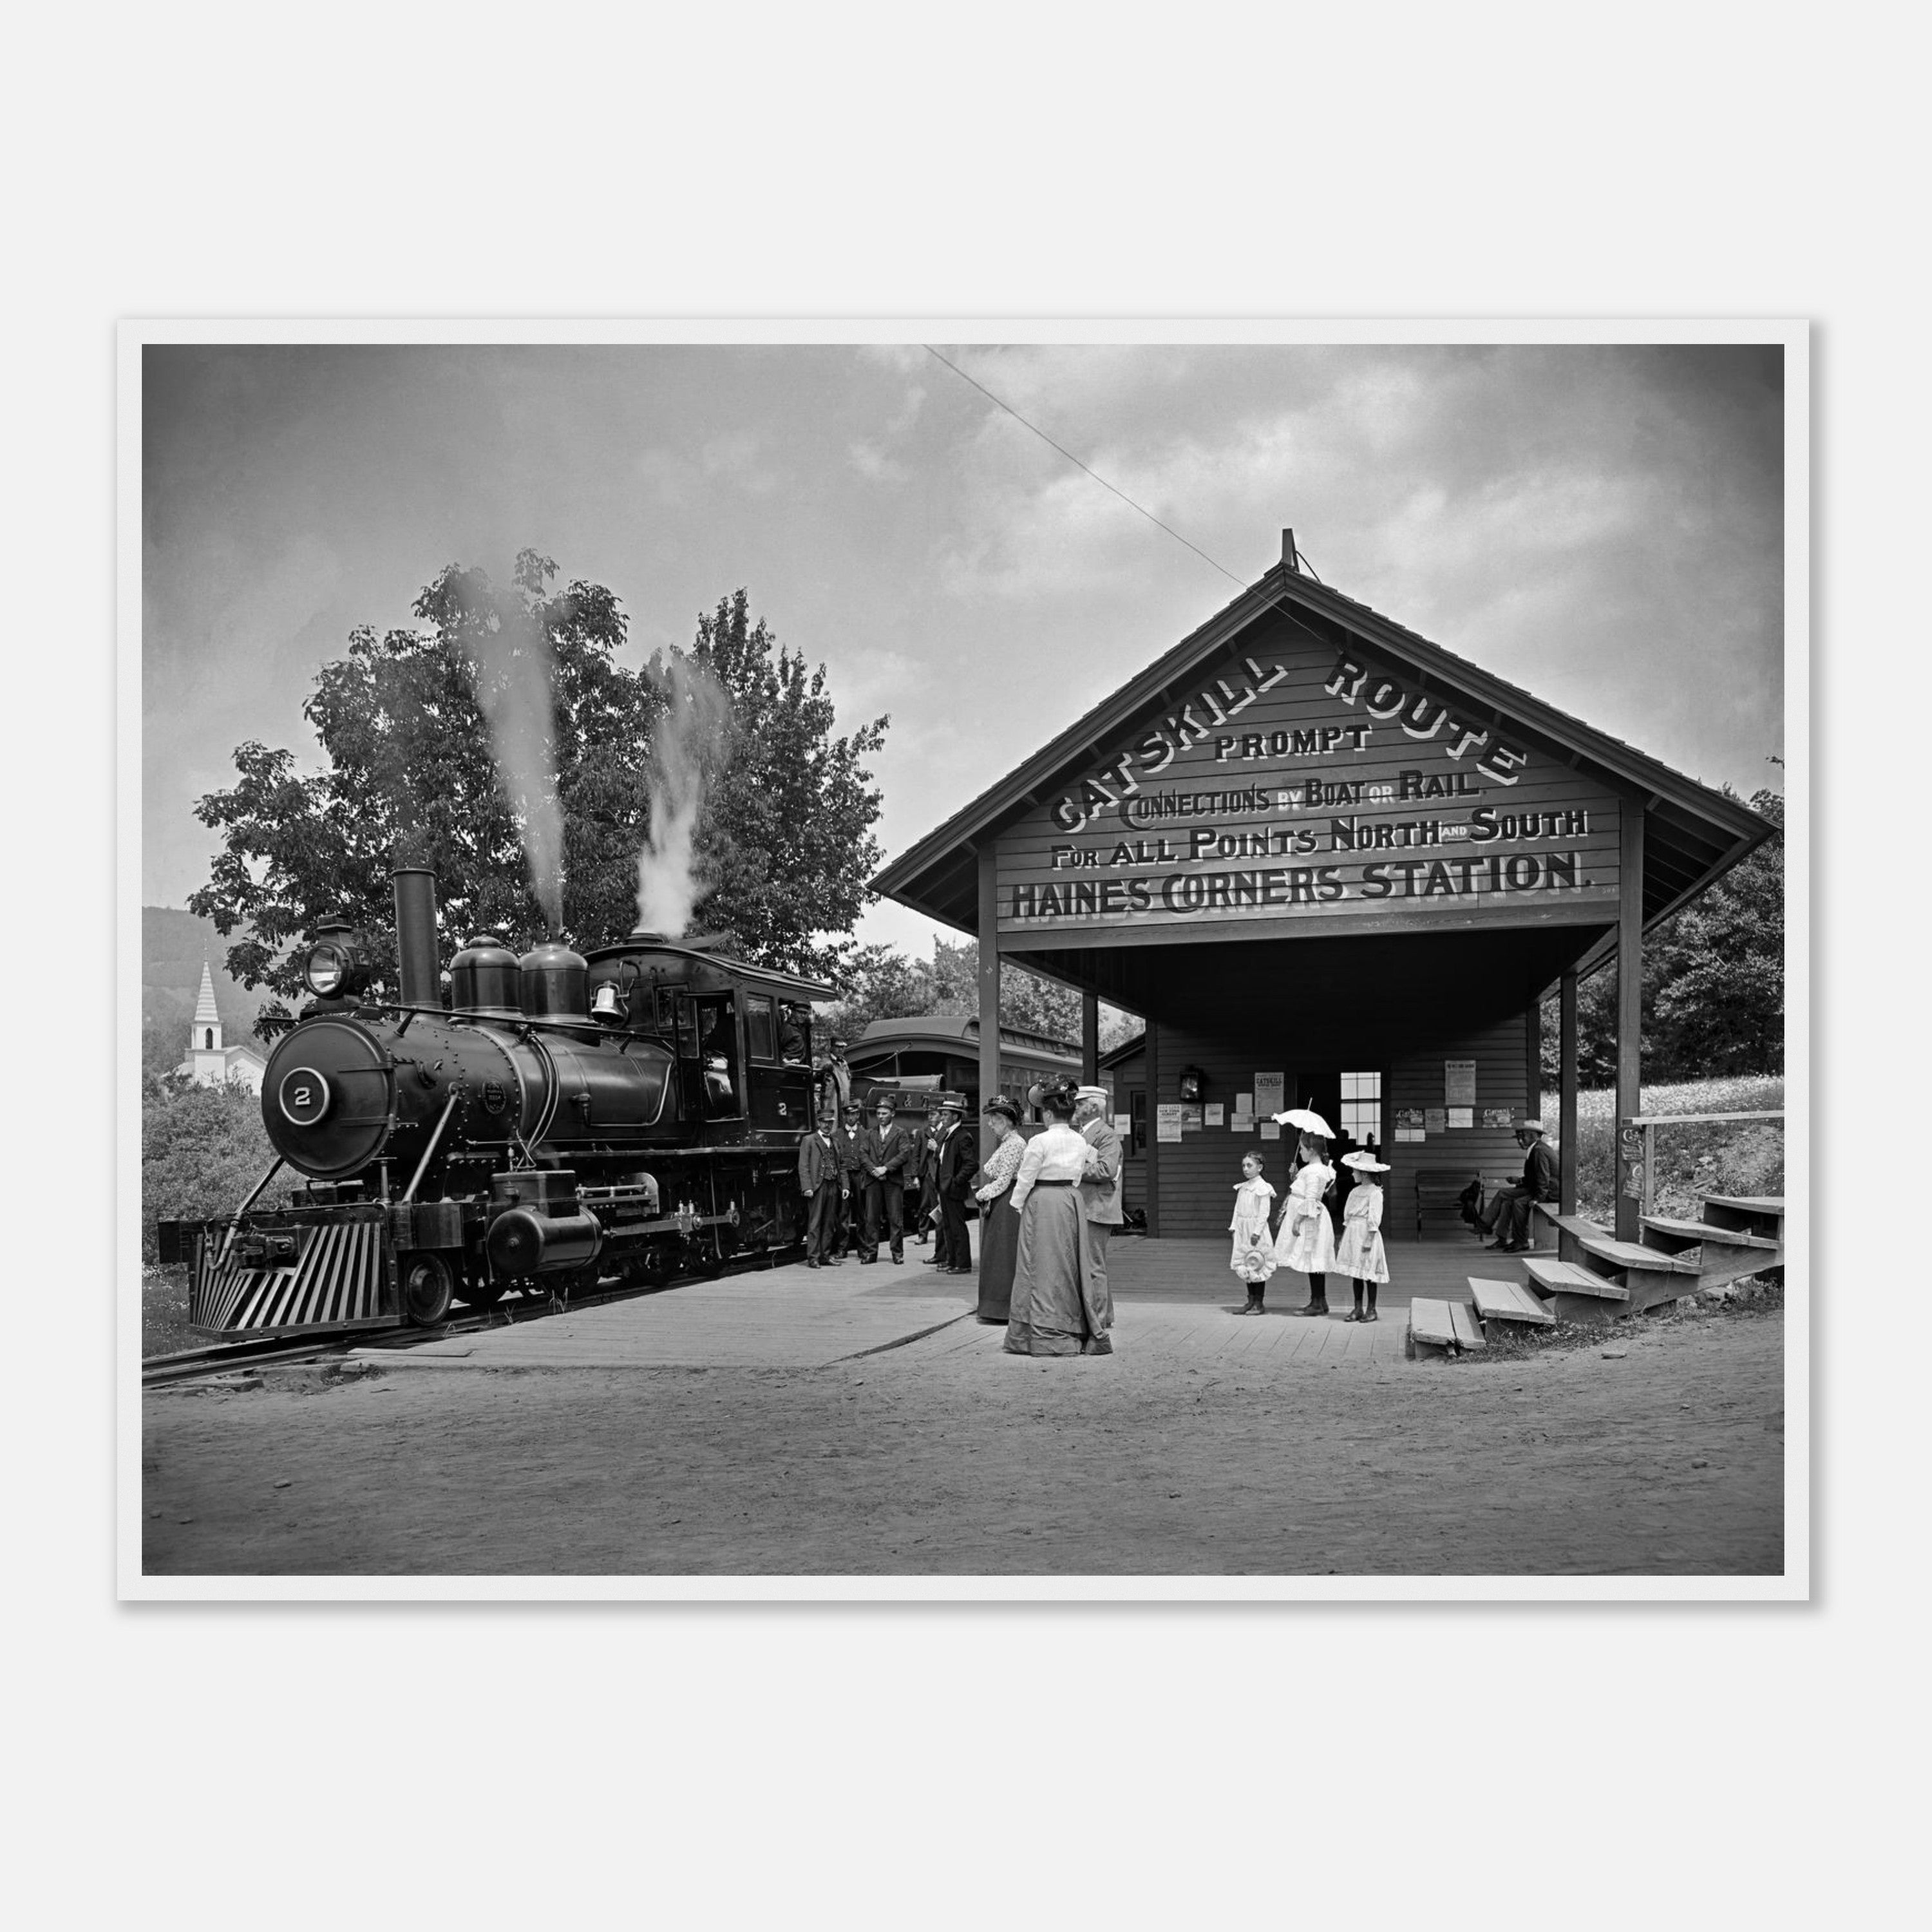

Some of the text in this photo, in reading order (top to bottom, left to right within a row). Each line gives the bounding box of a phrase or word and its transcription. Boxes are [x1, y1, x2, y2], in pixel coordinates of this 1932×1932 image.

[1051, 654, 1528, 833] CATSKILL ROUTE
[1215, 724, 1372, 762] PROMPT
[1277, 790, 1302, 811] BY
[1305, 778, 1366, 810] BOAT
[1369, 786, 1392, 804] OR
[1051, 844, 1099, 870] FOR
[1110, 838, 1178, 867] ALL
[1189, 826, 1318, 862] POINTS
[1331, 816, 1443, 854] NORTH
[1442, 824, 1467, 837] AND
[1012, 876, 1153, 923] HAINES
[1161, 867, 1349, 915] CORNERS
[294, 1087, 310, 1105] 2
[779, 1102, 787, 1116] 2
